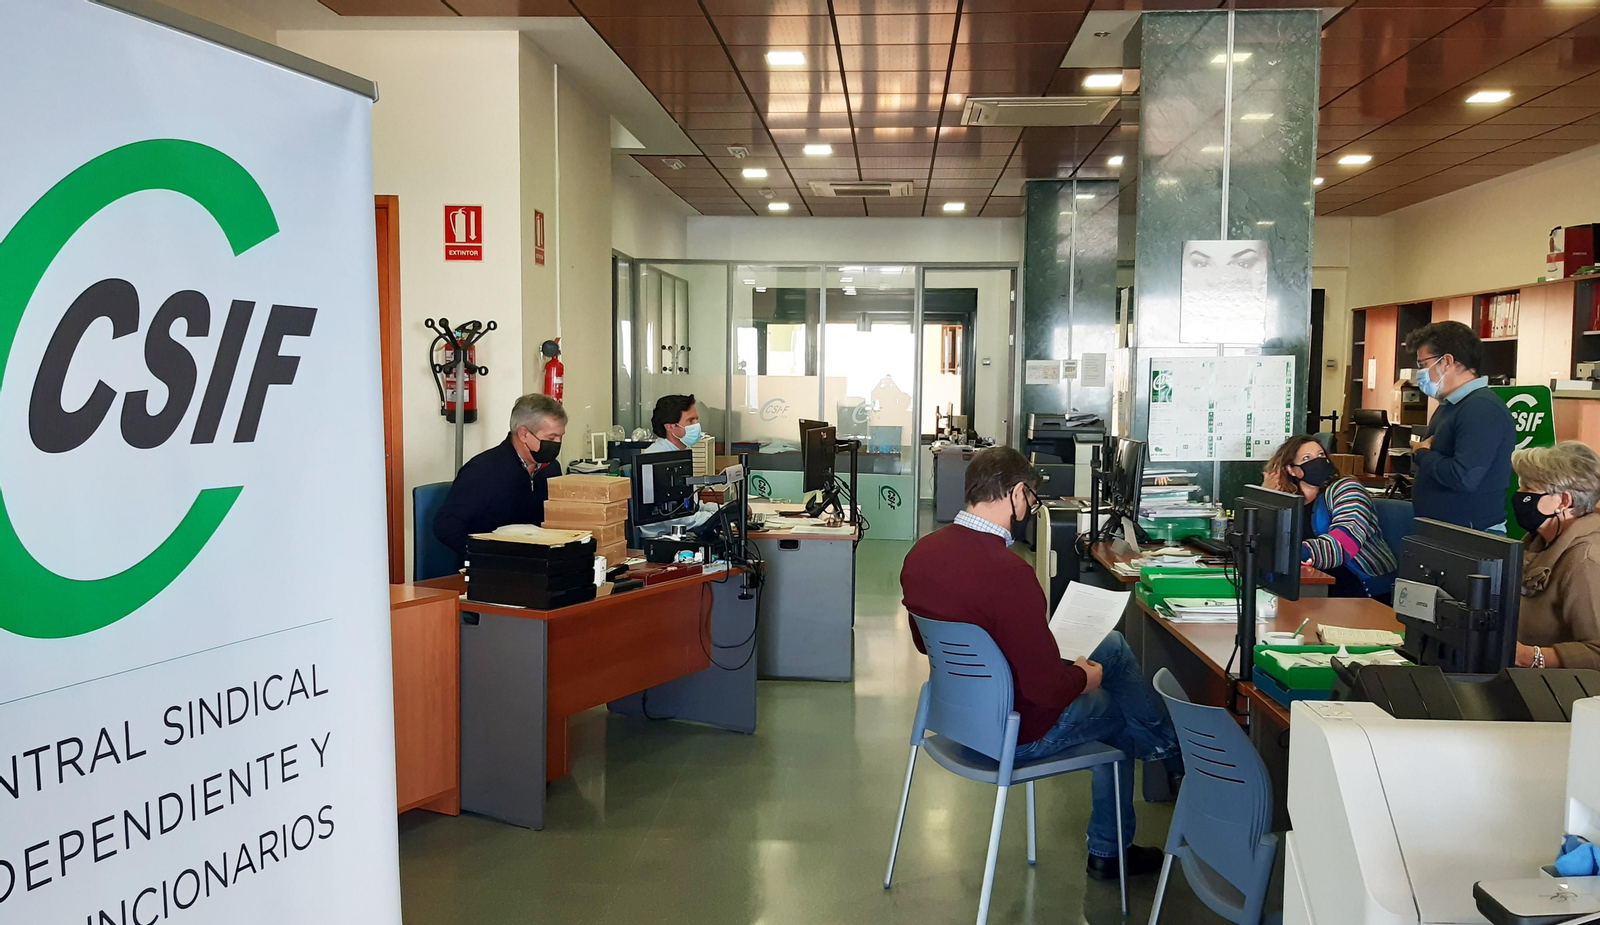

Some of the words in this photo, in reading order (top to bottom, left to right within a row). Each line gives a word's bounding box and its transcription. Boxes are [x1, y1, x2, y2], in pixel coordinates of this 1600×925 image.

[28, 278, 319, 454] CSIF
[163, 663, 329, 746] SINDICAL
[310, 731, 331, 768] Y
[87, 804, 335, 925] NCIONARIOS
